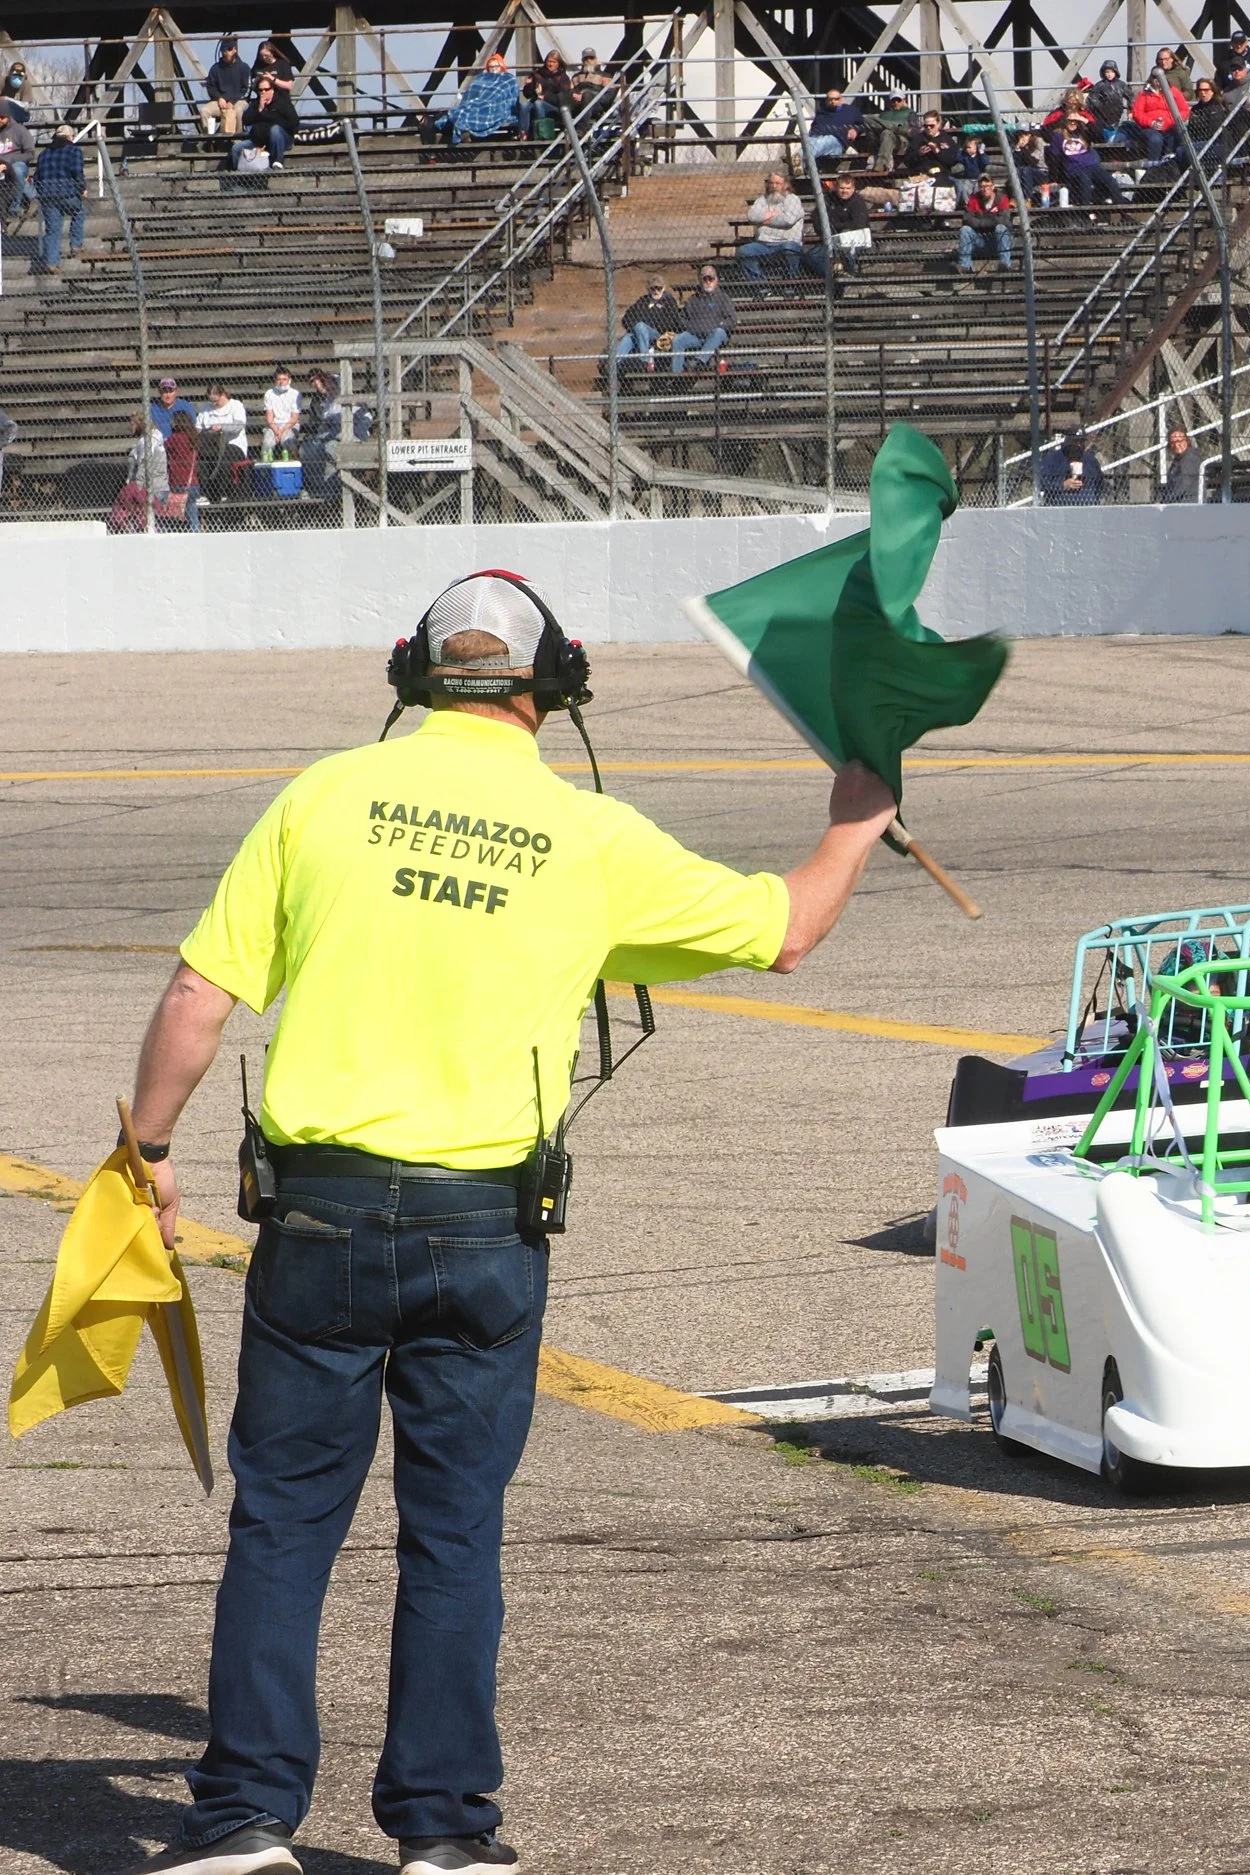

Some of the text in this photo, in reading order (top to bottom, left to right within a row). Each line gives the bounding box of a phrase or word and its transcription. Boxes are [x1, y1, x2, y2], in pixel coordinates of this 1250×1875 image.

[391, 445, 468, 455] LOWER PIT ENTRANCE
[443, 677, 463, 686] RACING
[368, 825, 546, 877] SPEEDWAY
[369, 801, 552, 855] KALAMAZOO
[392, 868, 509, 915] STAFF
[1010, 1214, 1072, 1375] 05
